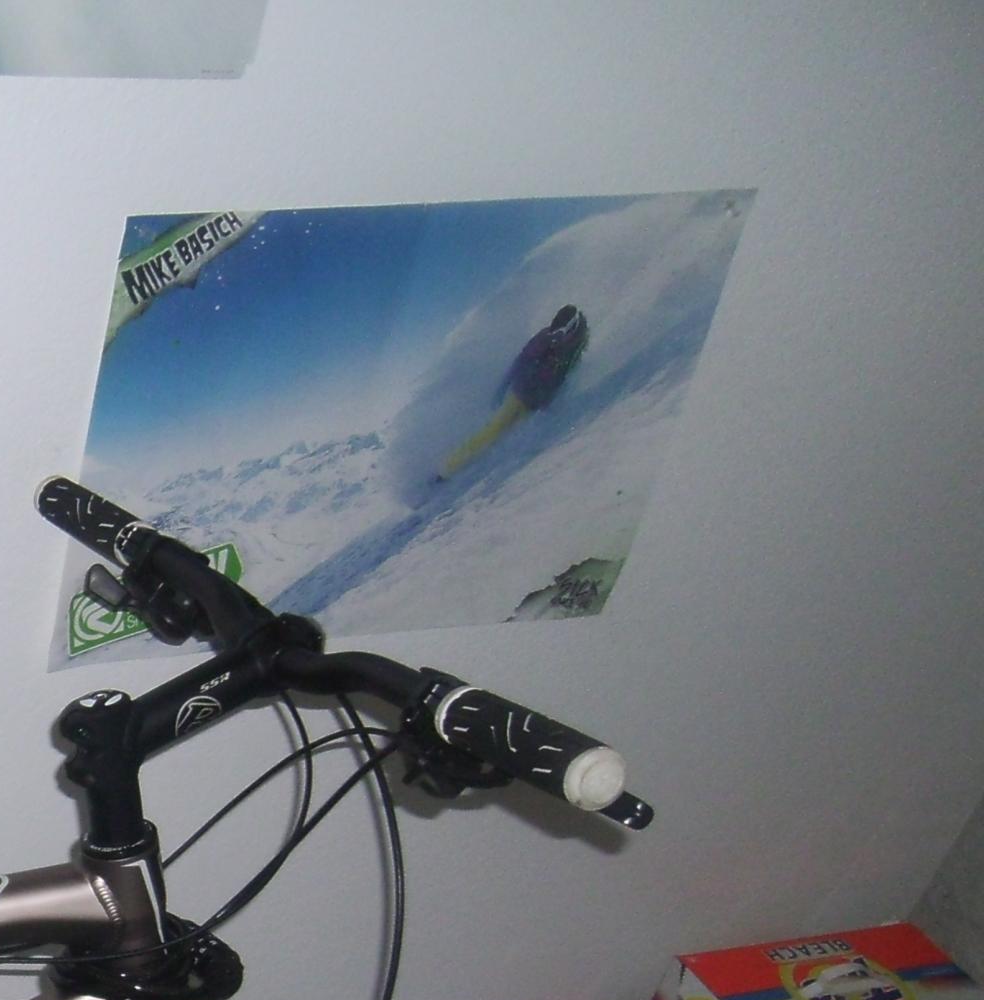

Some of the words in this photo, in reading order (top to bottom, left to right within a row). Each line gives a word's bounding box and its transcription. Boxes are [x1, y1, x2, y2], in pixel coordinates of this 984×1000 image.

[121, 249, 181, 304] MIKE
[174, 211, 243, 266] BASICH
[768, 938, 852, 961] BLEACH
